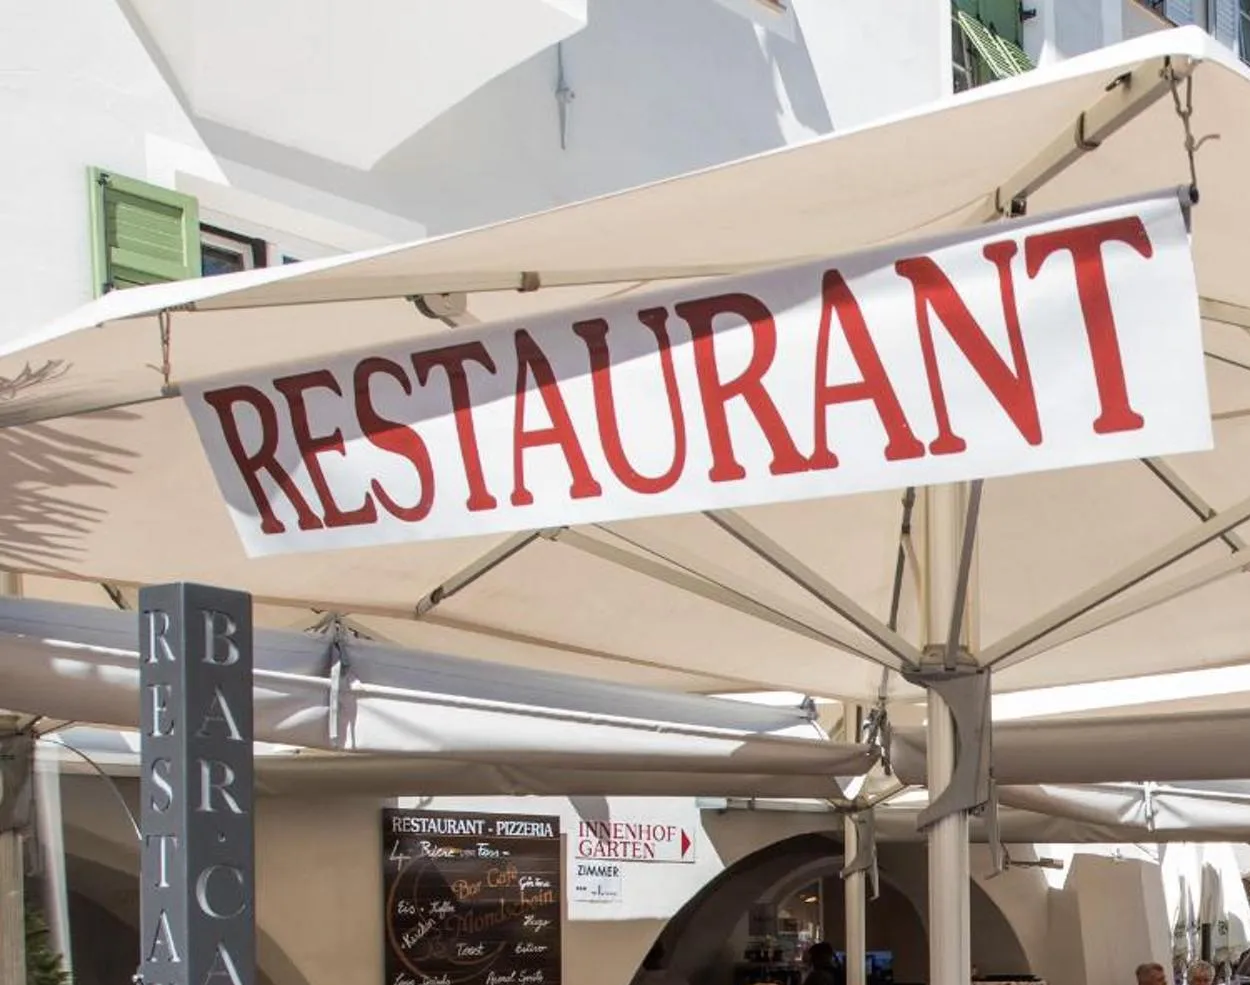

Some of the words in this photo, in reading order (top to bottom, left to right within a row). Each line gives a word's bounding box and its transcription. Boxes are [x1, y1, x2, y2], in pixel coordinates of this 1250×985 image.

[205, 216, 1154, 536] RESTAURANT
[392, 817, 486, 835] RESTAURANT
[496, 821, 554, 837] PIZZERIA
[578, 820, 677, 842] INNENHOF
[578, 840, 655, 859] GARTEN
[577, 864, 620, 878] ZIMMER
